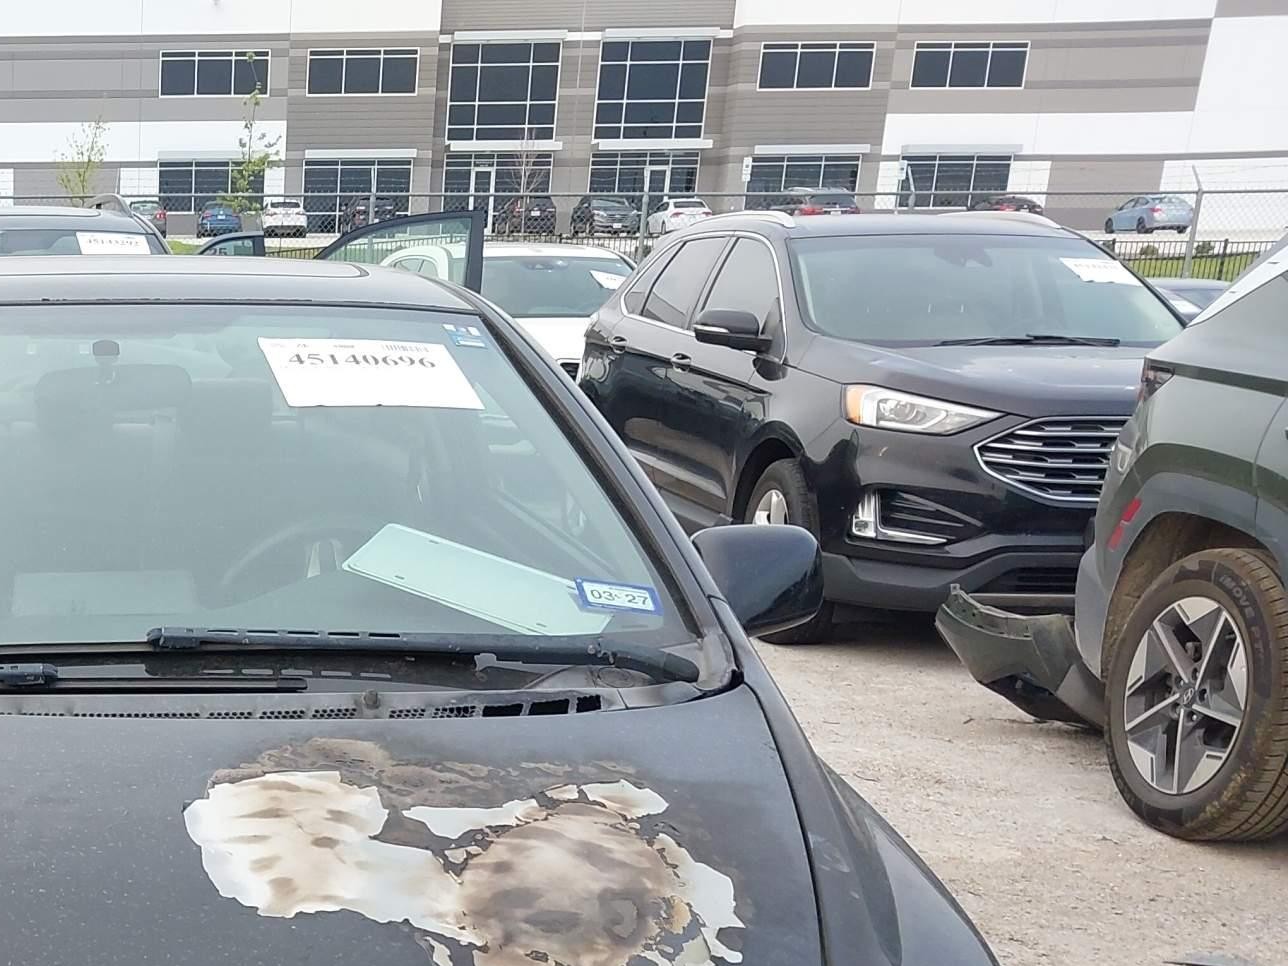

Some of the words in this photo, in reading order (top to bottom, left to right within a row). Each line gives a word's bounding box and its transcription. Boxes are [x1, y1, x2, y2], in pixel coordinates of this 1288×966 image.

[288, 353, 436, 369] 45140696
[590, 589, 615, 602] 03
[624, 593, 649, 605] 27
